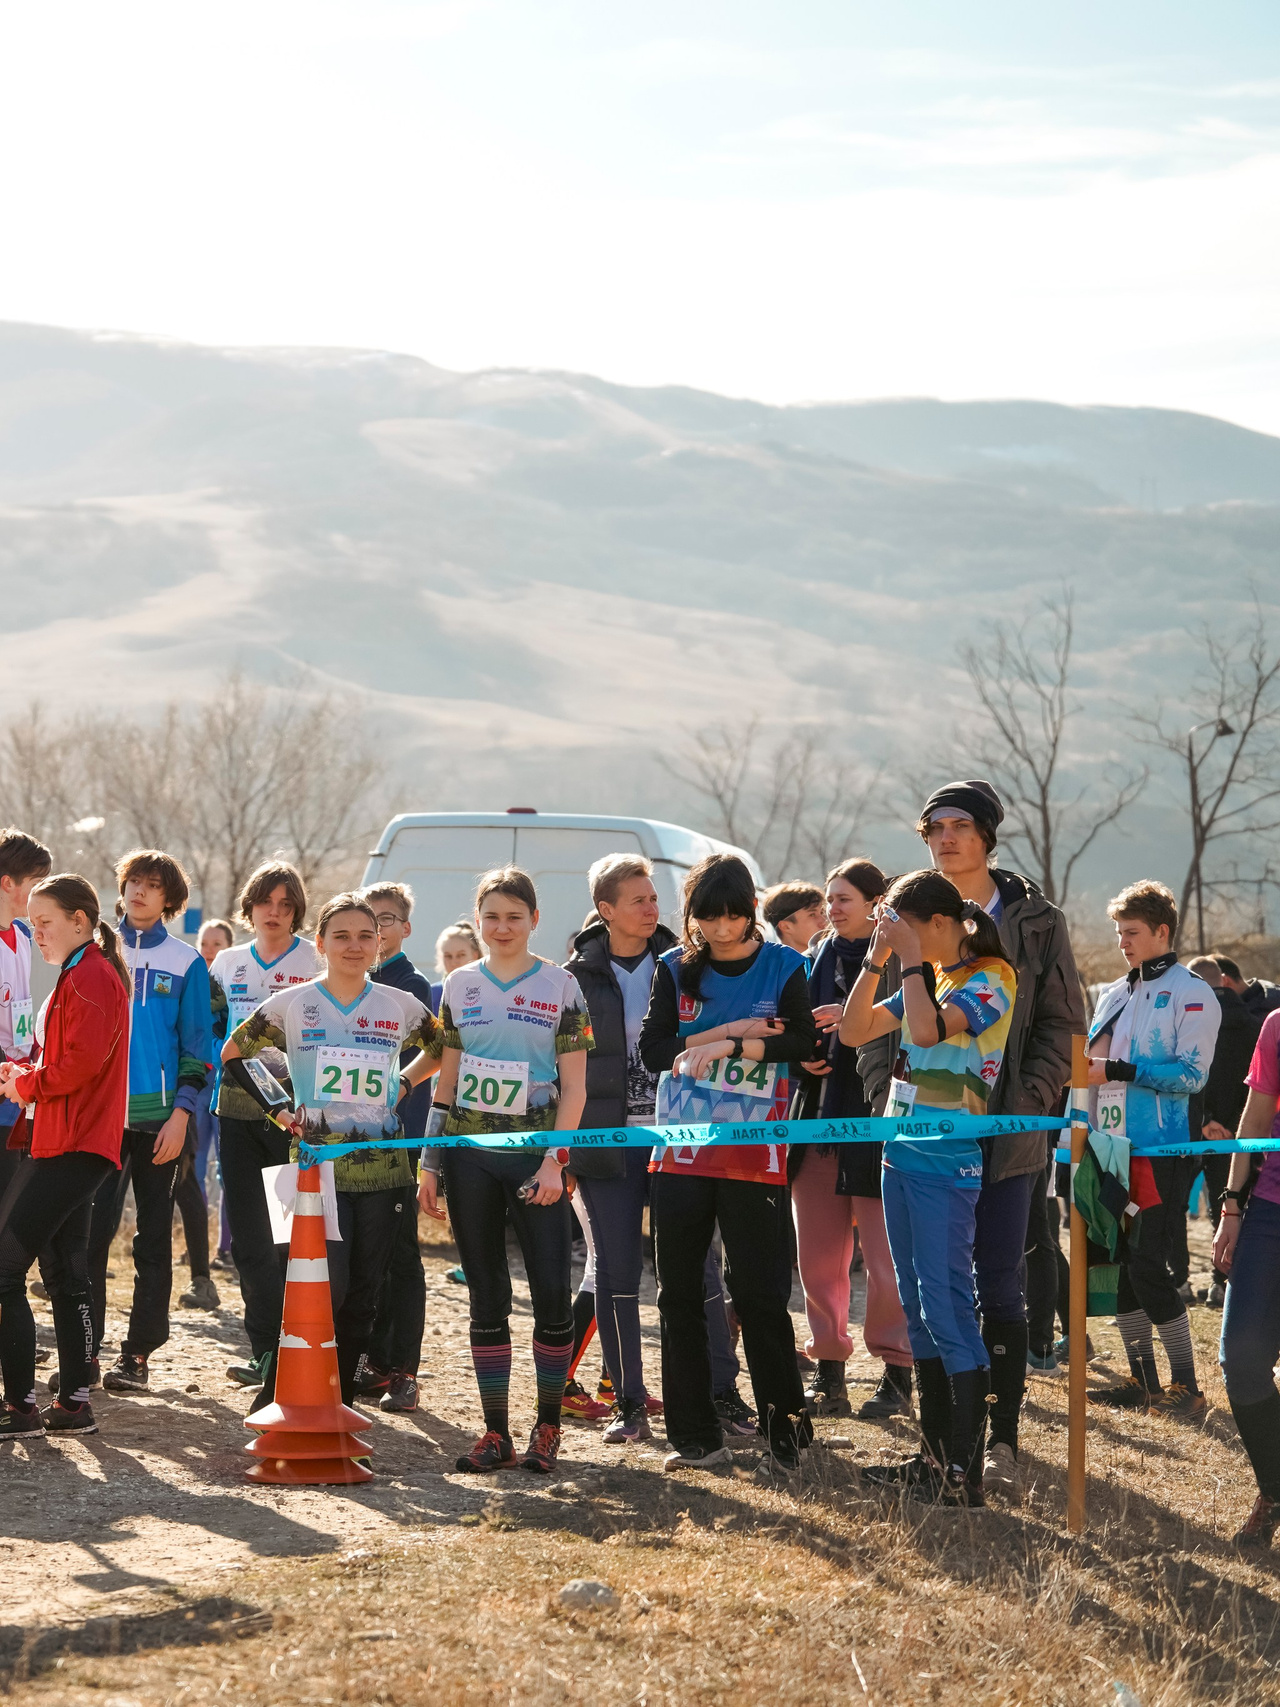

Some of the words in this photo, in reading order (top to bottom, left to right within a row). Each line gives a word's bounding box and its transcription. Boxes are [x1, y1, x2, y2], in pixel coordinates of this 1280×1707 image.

[530, 1000, 559, 1013] IRBIS
[374, 1020, 399, 1031] IRBIS
[355, 1036, 397, 1048] BELGOROD
[321, 1065, 383, 1098] 215
[708, 1057, 769, 1091] 164
[462, 1073, 523, 1108] 207
[1101, 1104, 1122, 1130] 29
[81, 1309, 93, 1364] NORDSKI
